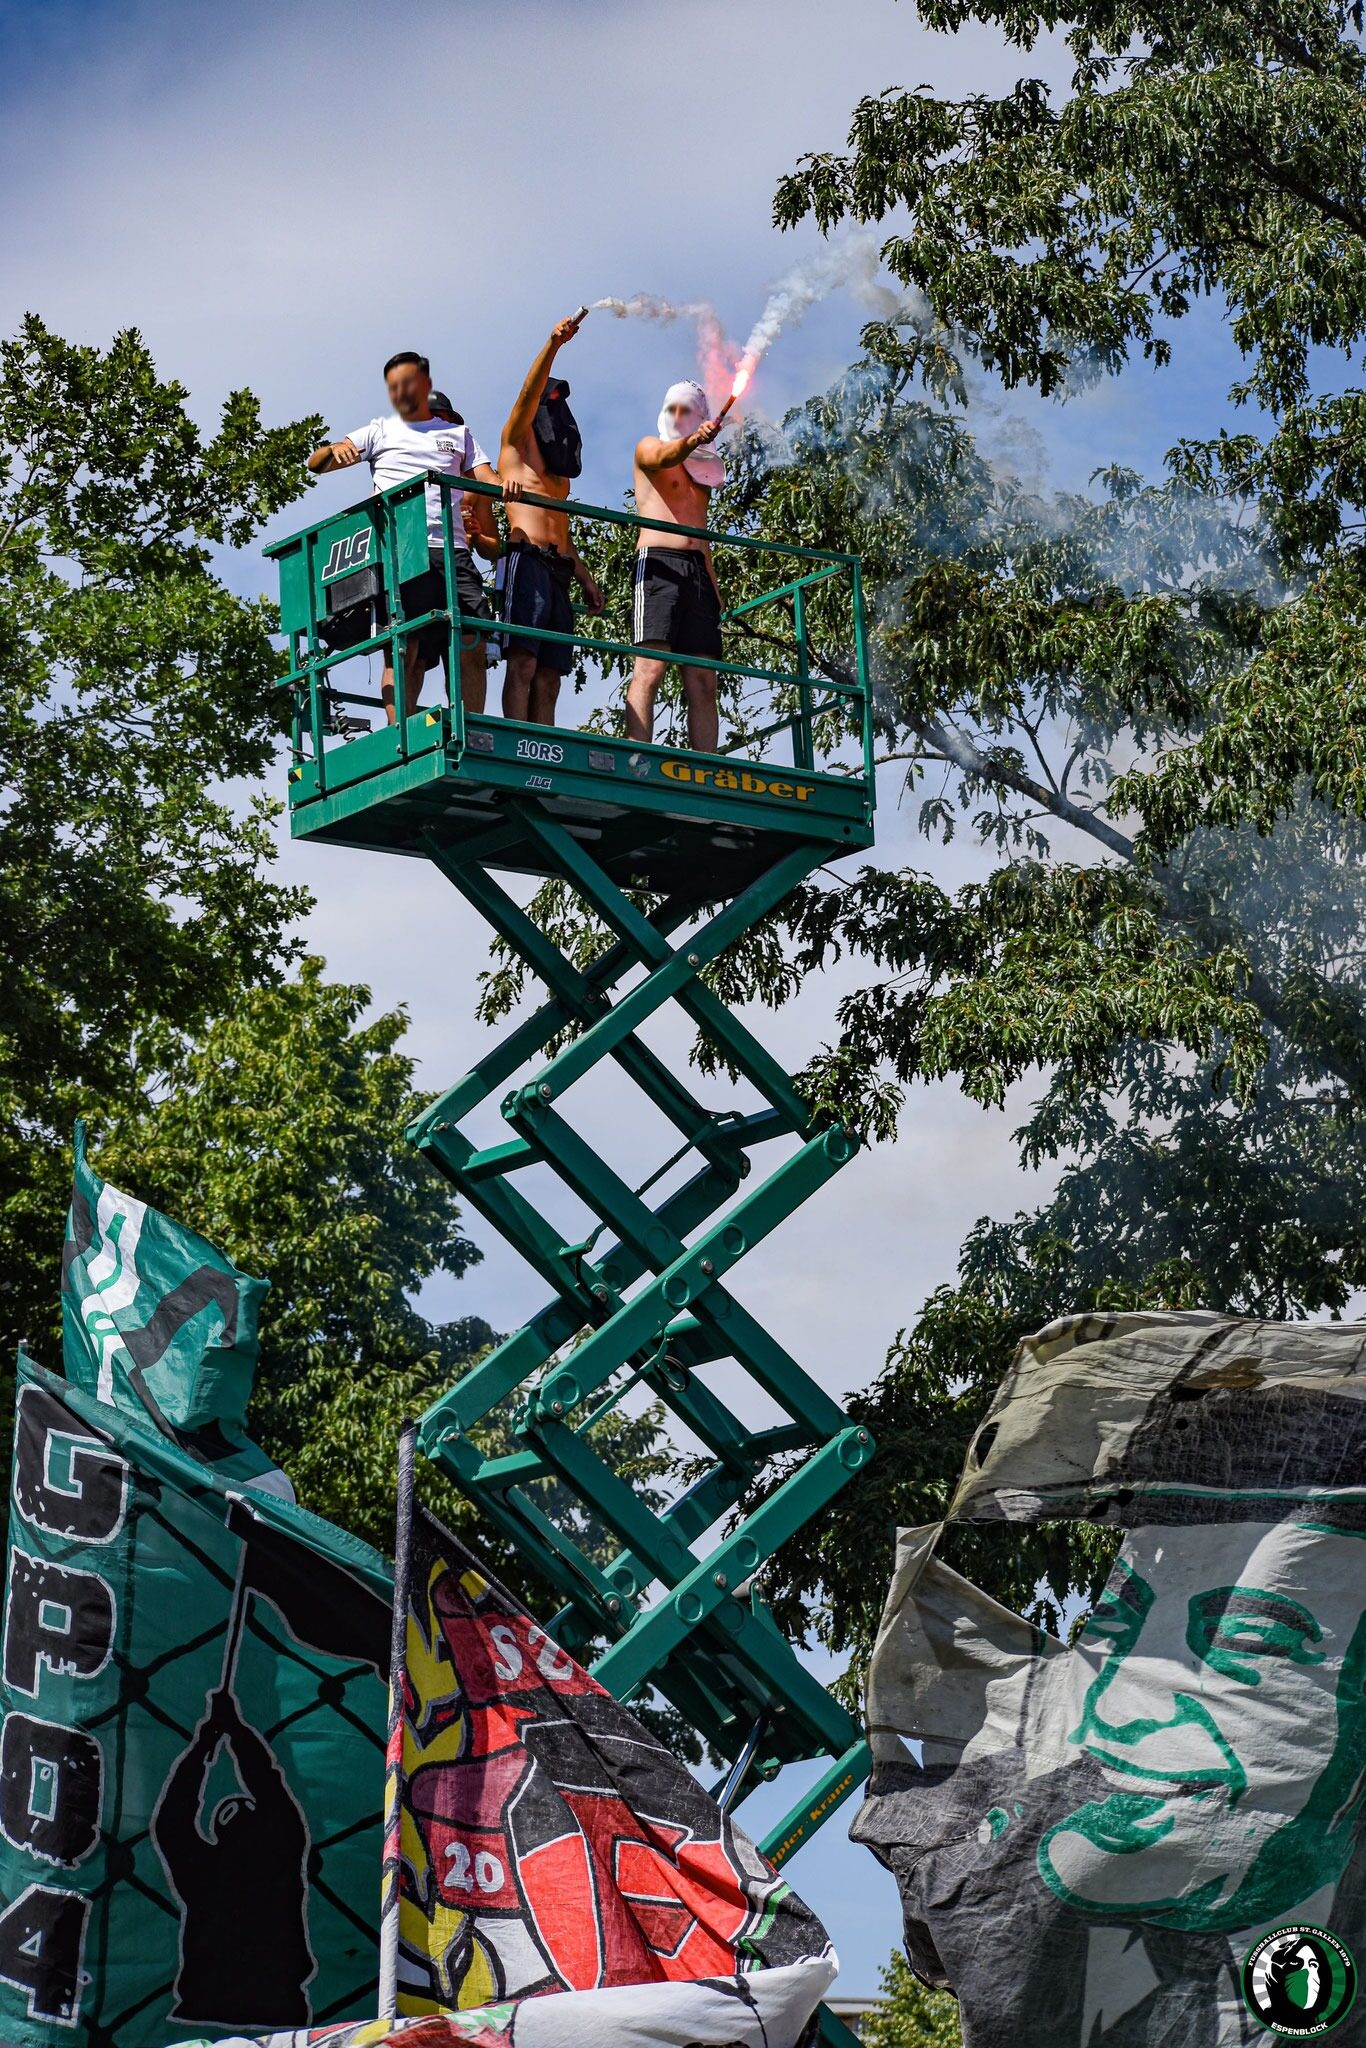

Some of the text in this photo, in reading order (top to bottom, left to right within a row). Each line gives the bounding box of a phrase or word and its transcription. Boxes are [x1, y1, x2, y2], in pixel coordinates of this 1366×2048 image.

[321, 526, 373, 581] JLG
[516, 738, 564, 764] 10RS
[525, 775, 552, 790] JLG
[659, 760, 816, 801] Gräber
[768, 1825, 804, 1866] apler
[443, 1841, 505, 1893] 20
